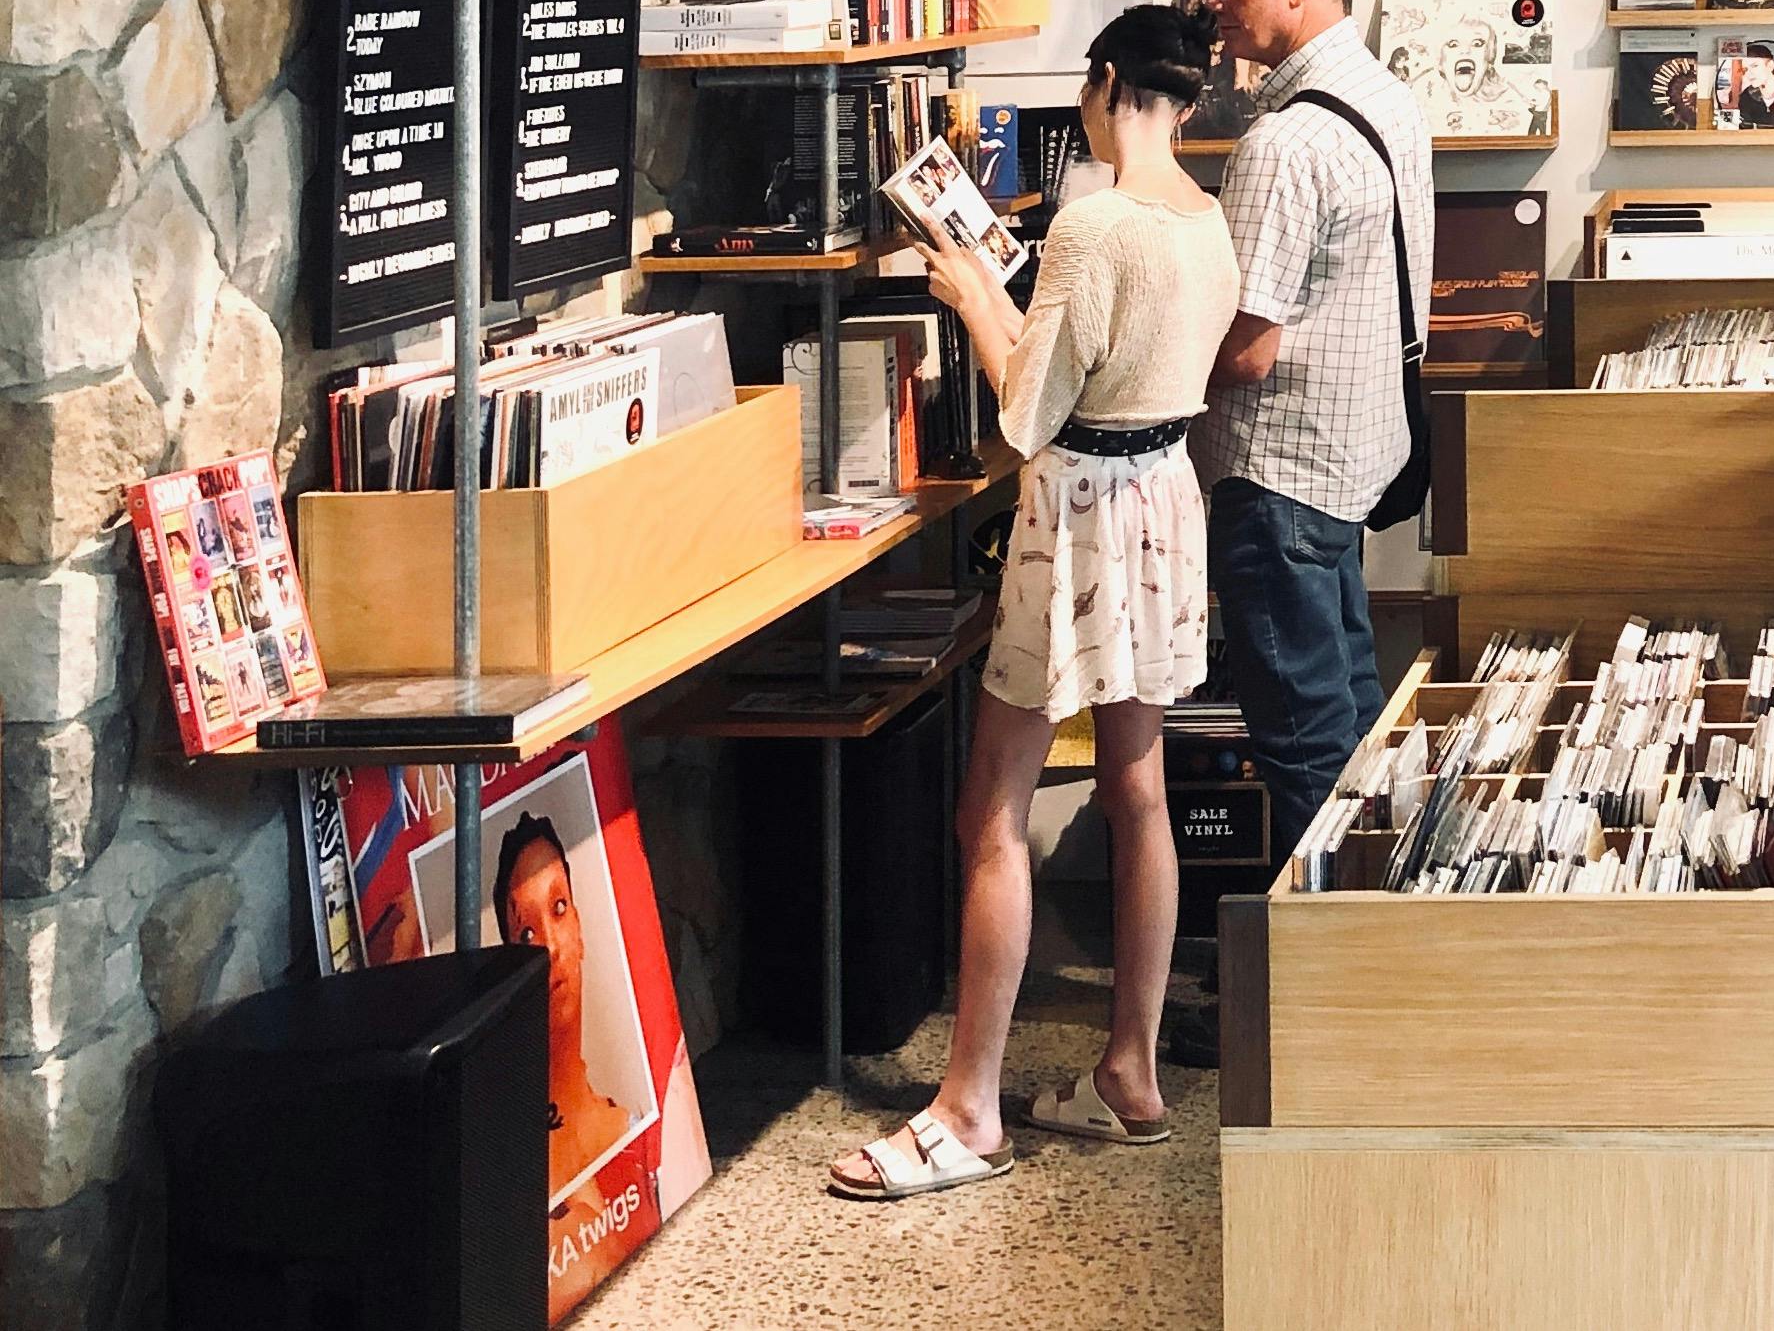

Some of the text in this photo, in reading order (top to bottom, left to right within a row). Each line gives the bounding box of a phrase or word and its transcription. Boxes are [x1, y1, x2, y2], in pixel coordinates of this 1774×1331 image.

[549, 388, 581, 424] AMYL
[596, 365, 648, 408] SNIFFERS
[270, 722, 326, 745] Hi-Fi
[1189, 808, 1229, 821] SALE
[1184, 824, 1235, 837] VINYL
[579, 1183, 641, 1254] twigs
